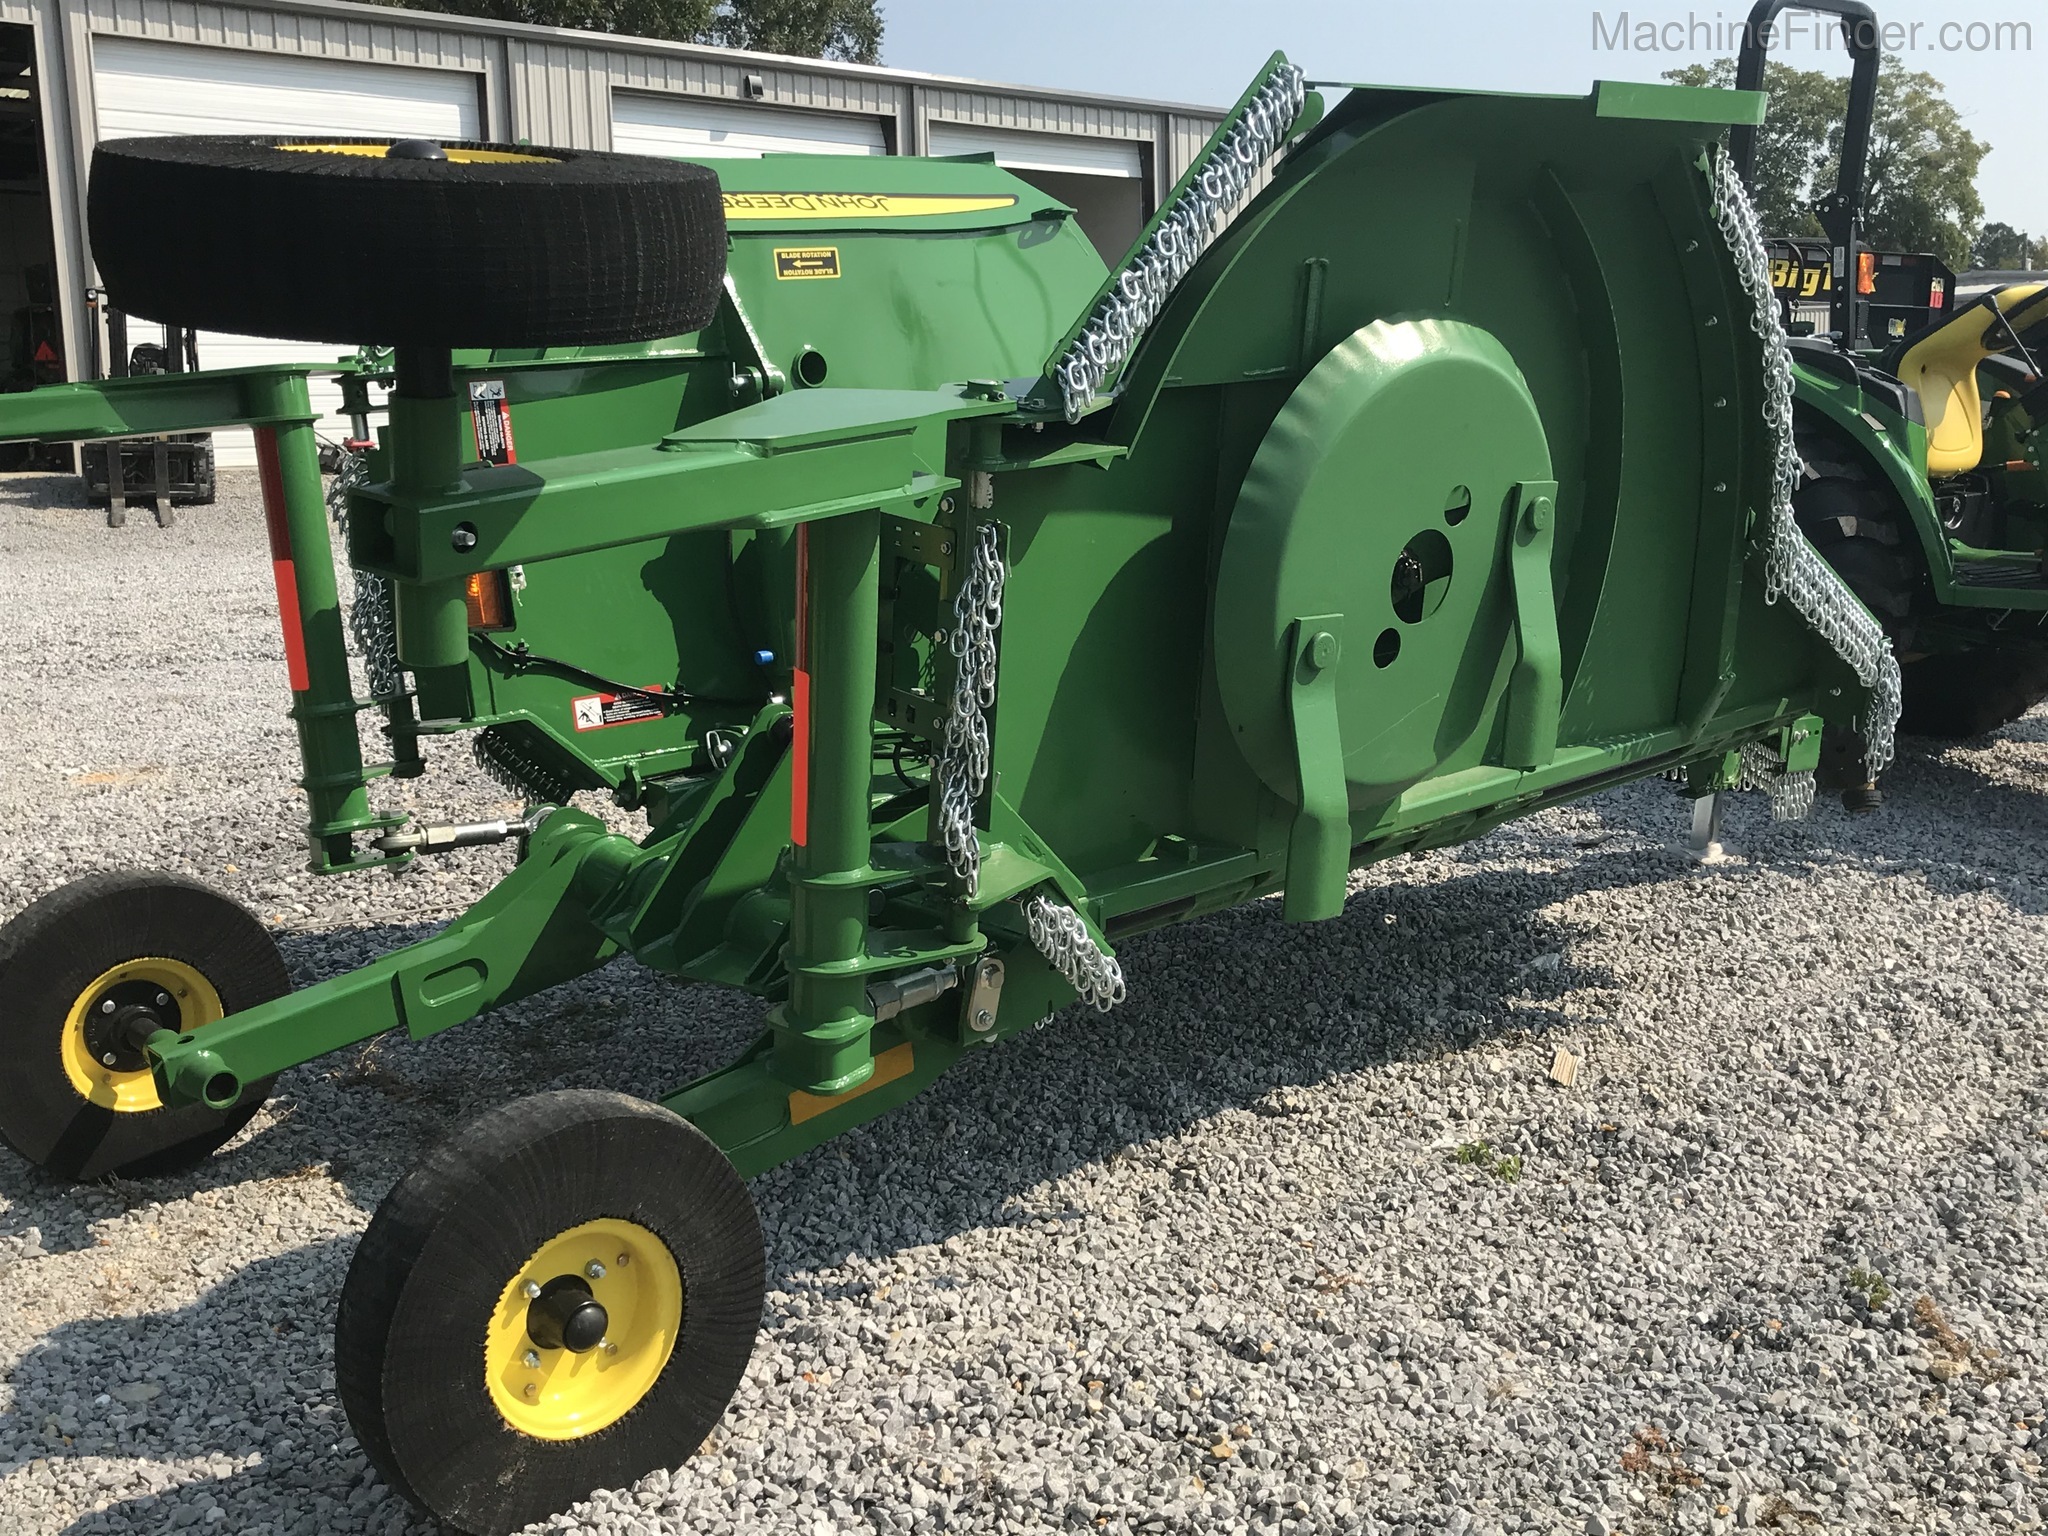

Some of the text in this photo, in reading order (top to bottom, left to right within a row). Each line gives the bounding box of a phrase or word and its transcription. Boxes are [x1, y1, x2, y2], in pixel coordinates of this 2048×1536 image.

[723, 196, 890, 212] JOHN DEERE
[801, 251, 831, 259] ROTATION
[783, 268, 814, 276] ROTATION
[503, 420, 514, 451] DANGER
